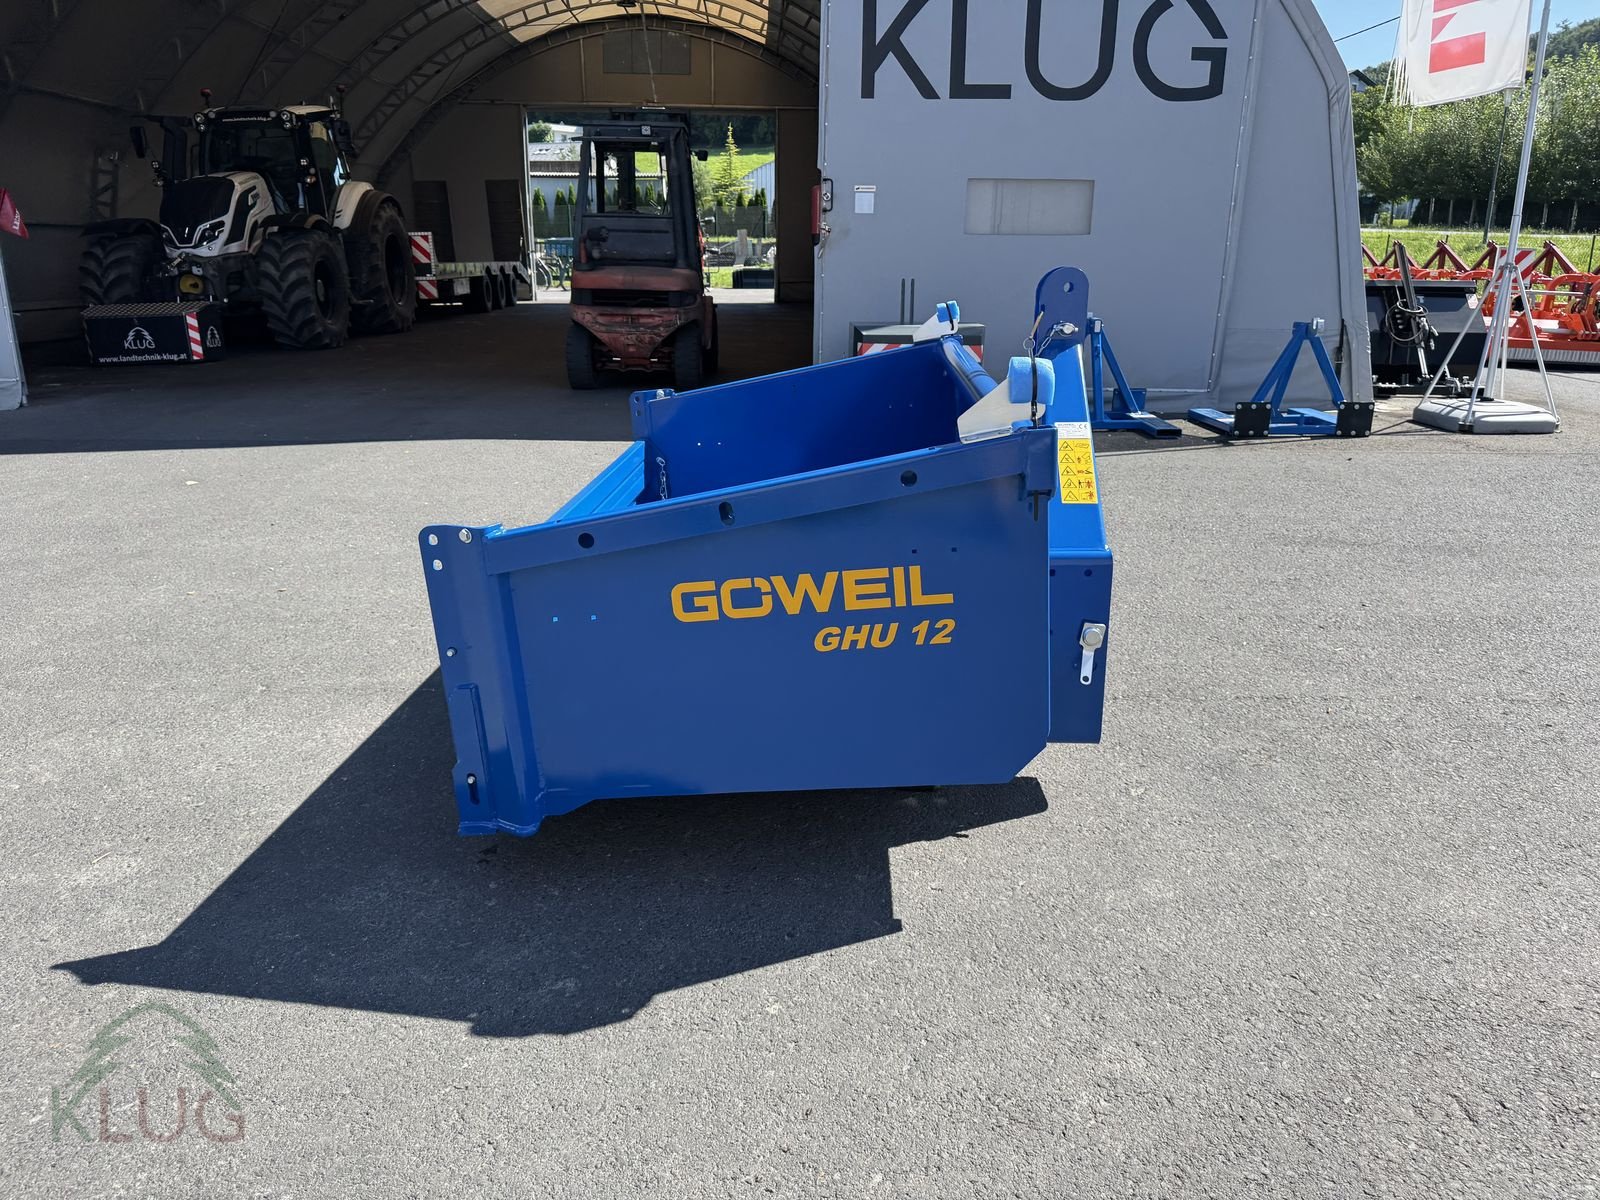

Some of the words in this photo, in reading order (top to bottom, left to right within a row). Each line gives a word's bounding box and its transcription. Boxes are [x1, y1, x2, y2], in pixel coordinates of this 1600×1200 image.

[861, 0, 1229, 102] KLUG
[124, 339, 155, 349] KLUG
[99, 353, 187, 363] www.landtechnik-klug.at
[814, 622, 899, 652] GHU
[911, 618, 956, 645] 12
